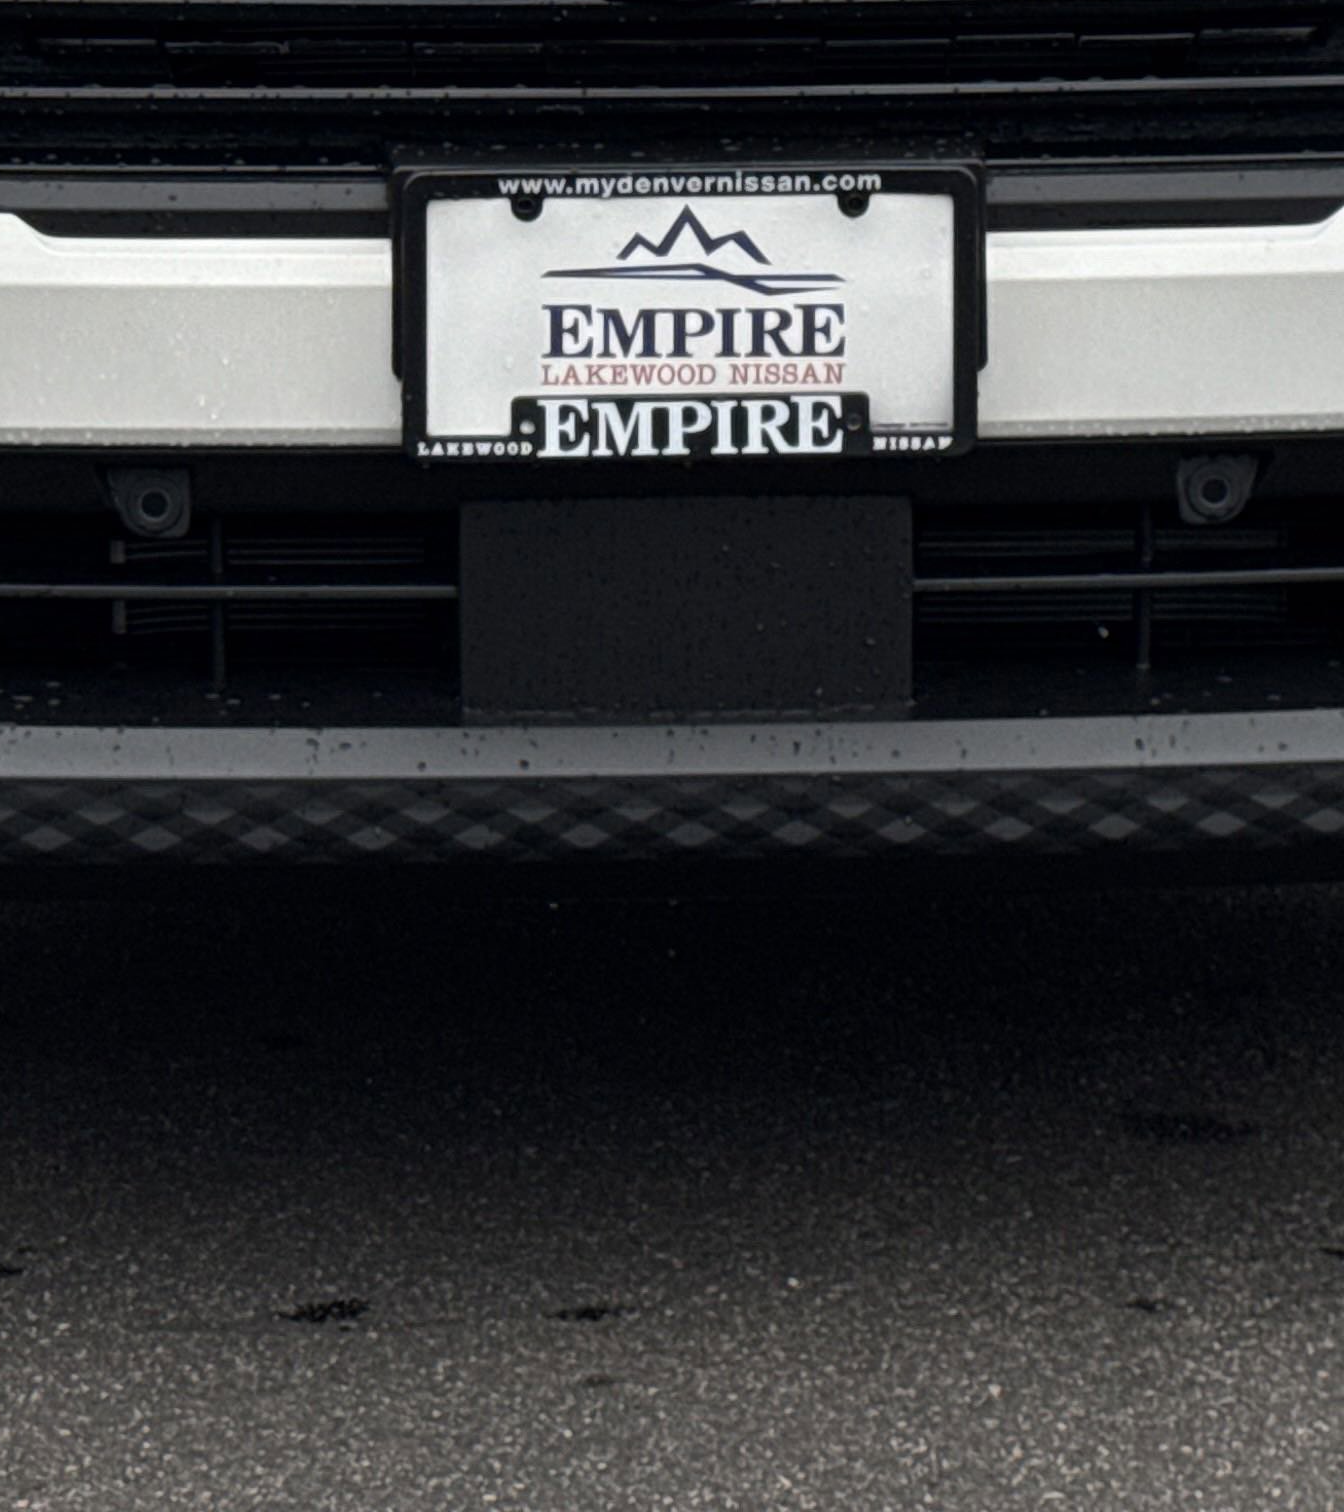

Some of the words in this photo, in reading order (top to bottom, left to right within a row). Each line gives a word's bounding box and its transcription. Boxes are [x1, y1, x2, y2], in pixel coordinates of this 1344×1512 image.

[497, 170, 882, 198] www.mydenvernissan.com
[541, 303, 846, 359] EMPIRE
[541, 363, 717, 386] LAKEWOOD
[728, 362, 846, 385] NISSAN
[536, 394, 845, 458] EMPIRE
[416, 440, 534, 457] LAKEWOOD
